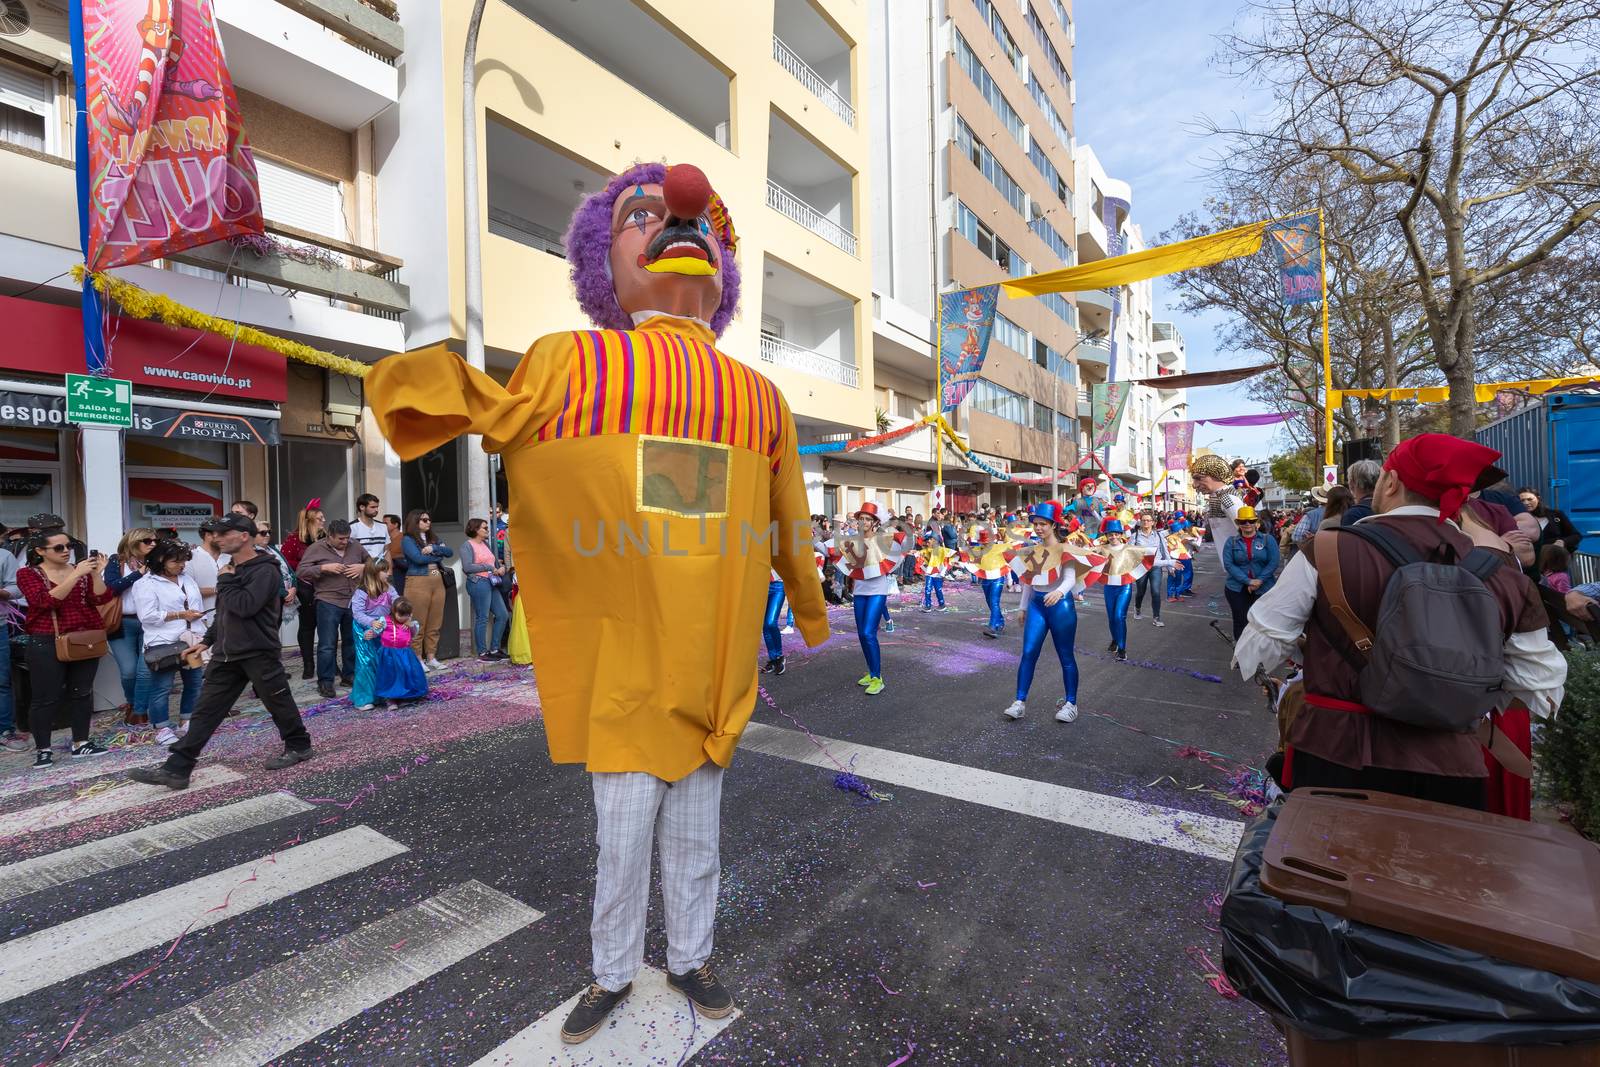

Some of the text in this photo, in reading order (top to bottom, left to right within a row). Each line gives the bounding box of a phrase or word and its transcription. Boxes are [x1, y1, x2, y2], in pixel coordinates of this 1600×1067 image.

[143, 365, 252, 389] www.caovivio.pt
[78, 403, 107, 412] SAÍDA
[69, 411, 131, 422] EMERGÊNCIA
[203, 422, 237, 431] PURINA
